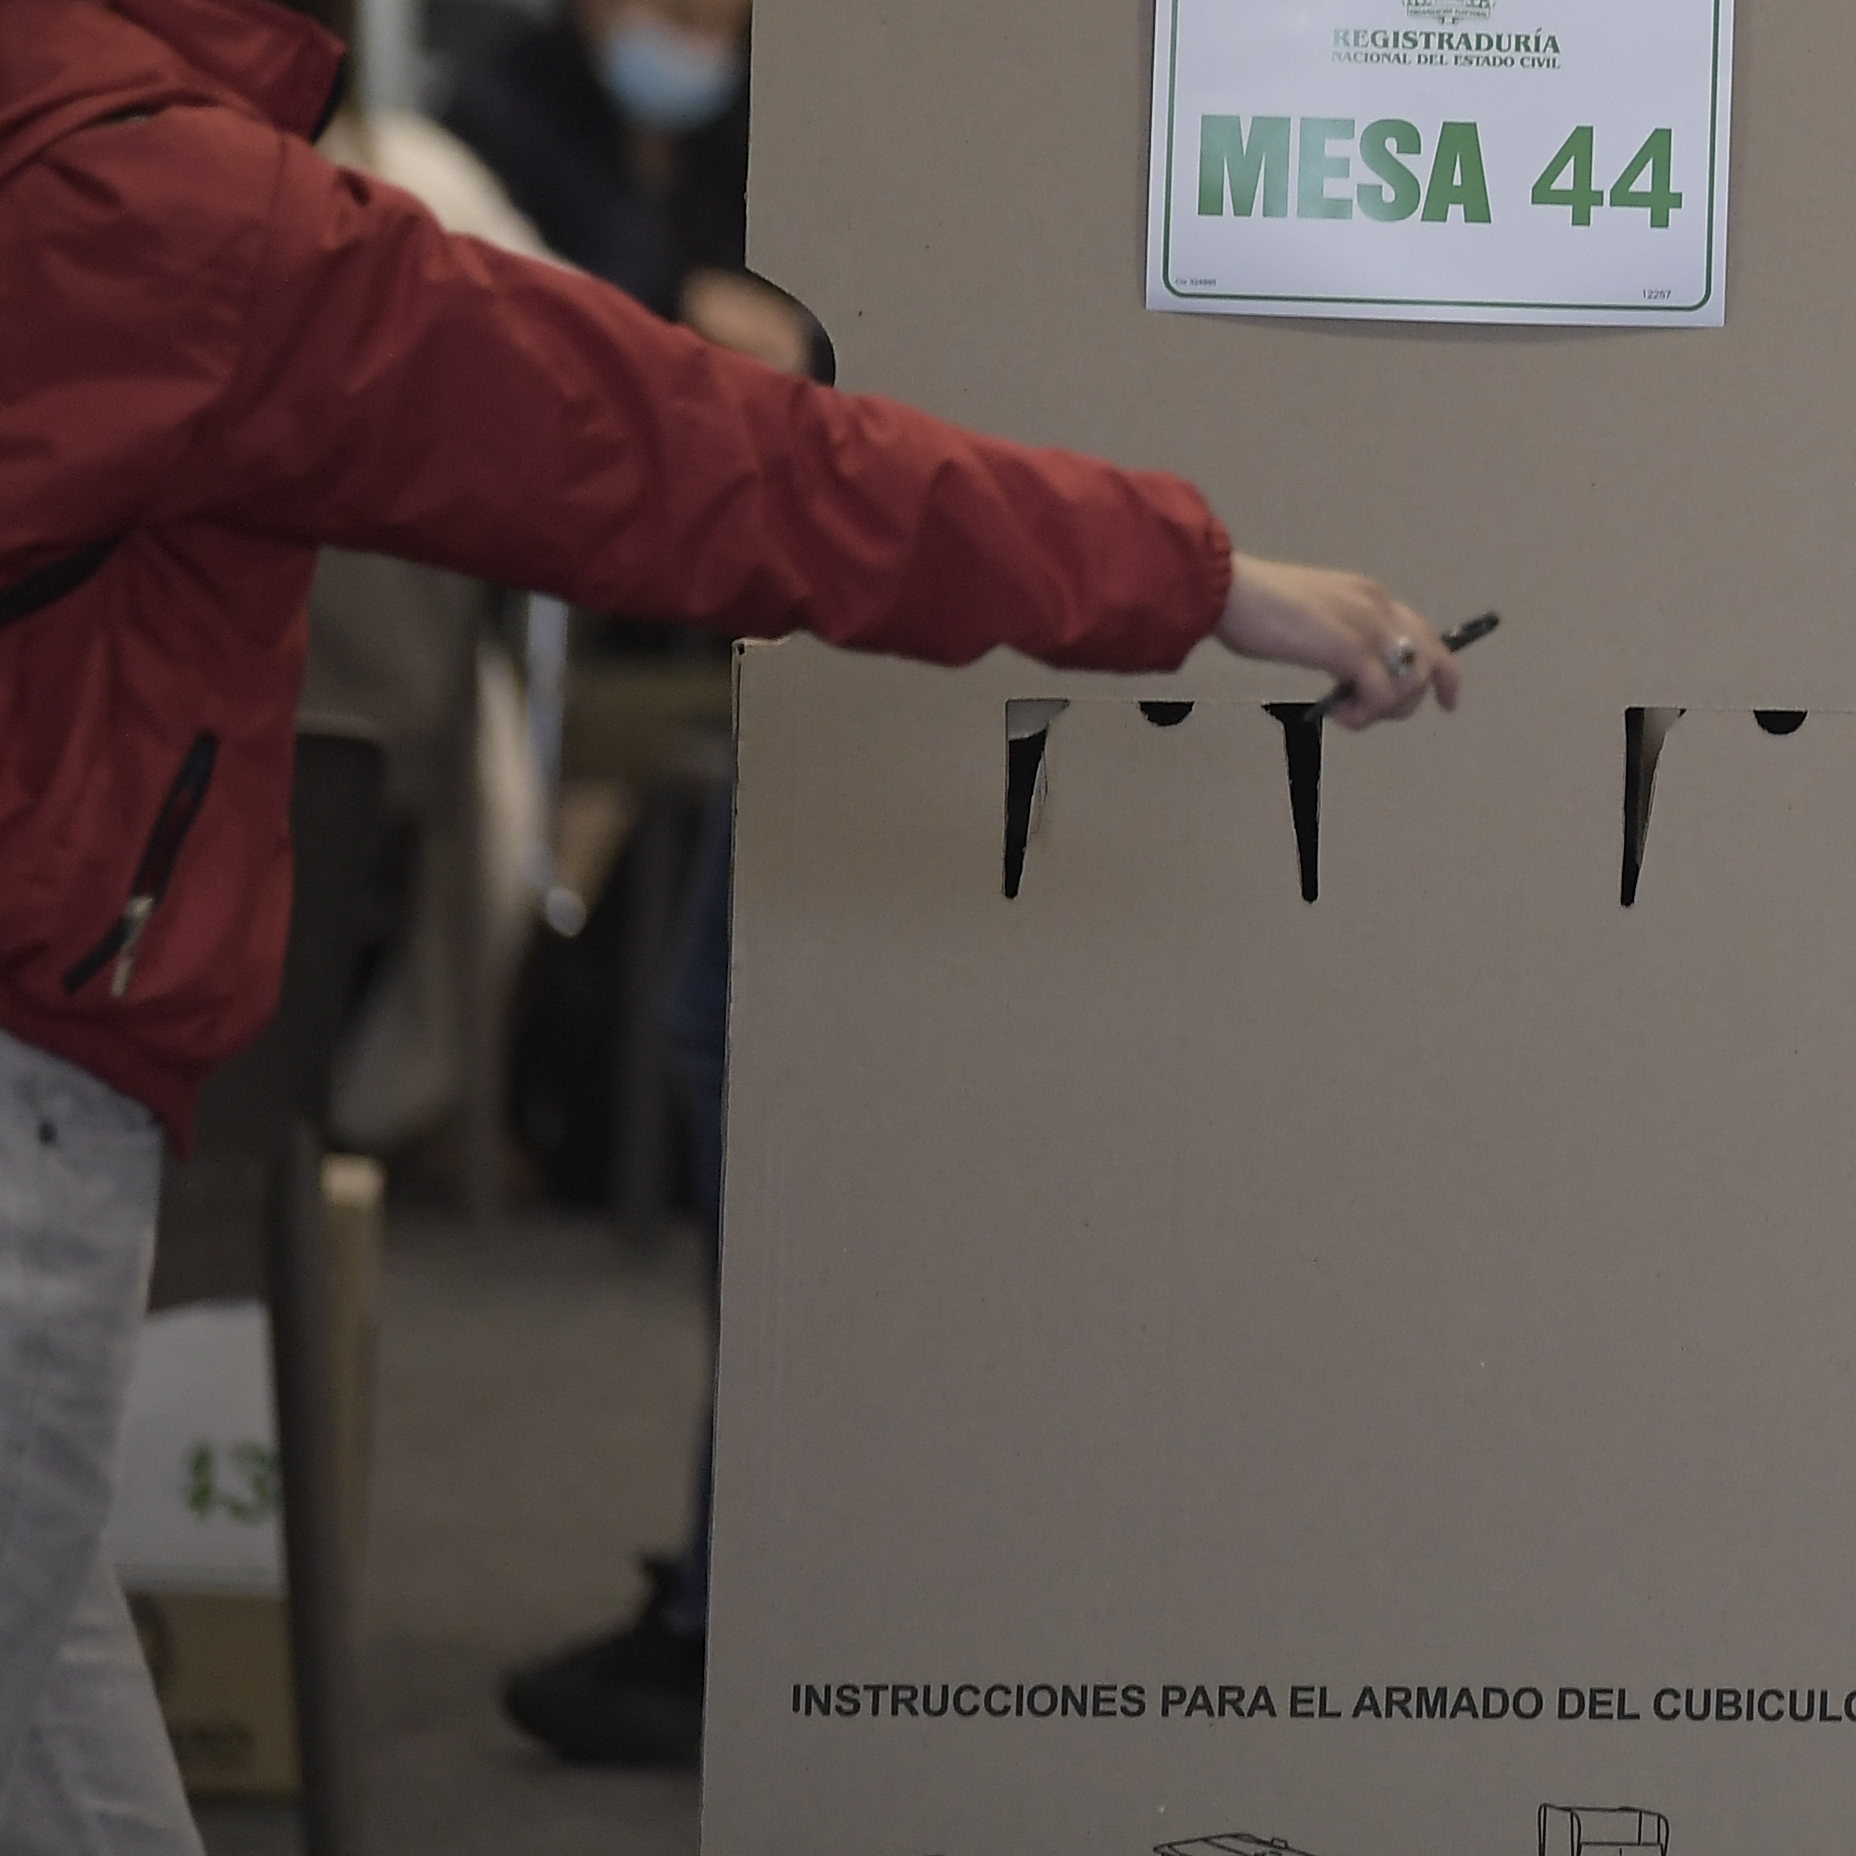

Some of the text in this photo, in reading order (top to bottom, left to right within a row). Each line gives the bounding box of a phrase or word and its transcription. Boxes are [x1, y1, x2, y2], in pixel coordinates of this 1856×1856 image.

[1332, 27, 1561, 54] REGISTRADURÍA
[1331, 51, 1561, 70] NACIONAL DEL ESTADO CIVIL
[1197, 114, 1683, 229] MESA 44
[792, 1683, 1146, 1718] INSTRUCCIONES
[1160, 1684, 1277, 1718] PARA
[1289, 1685, 1341, 1719] EL
[1352, 1685, 1544, 1721] ARMADO
[1557, 1686, 1641, 1721] DEL
